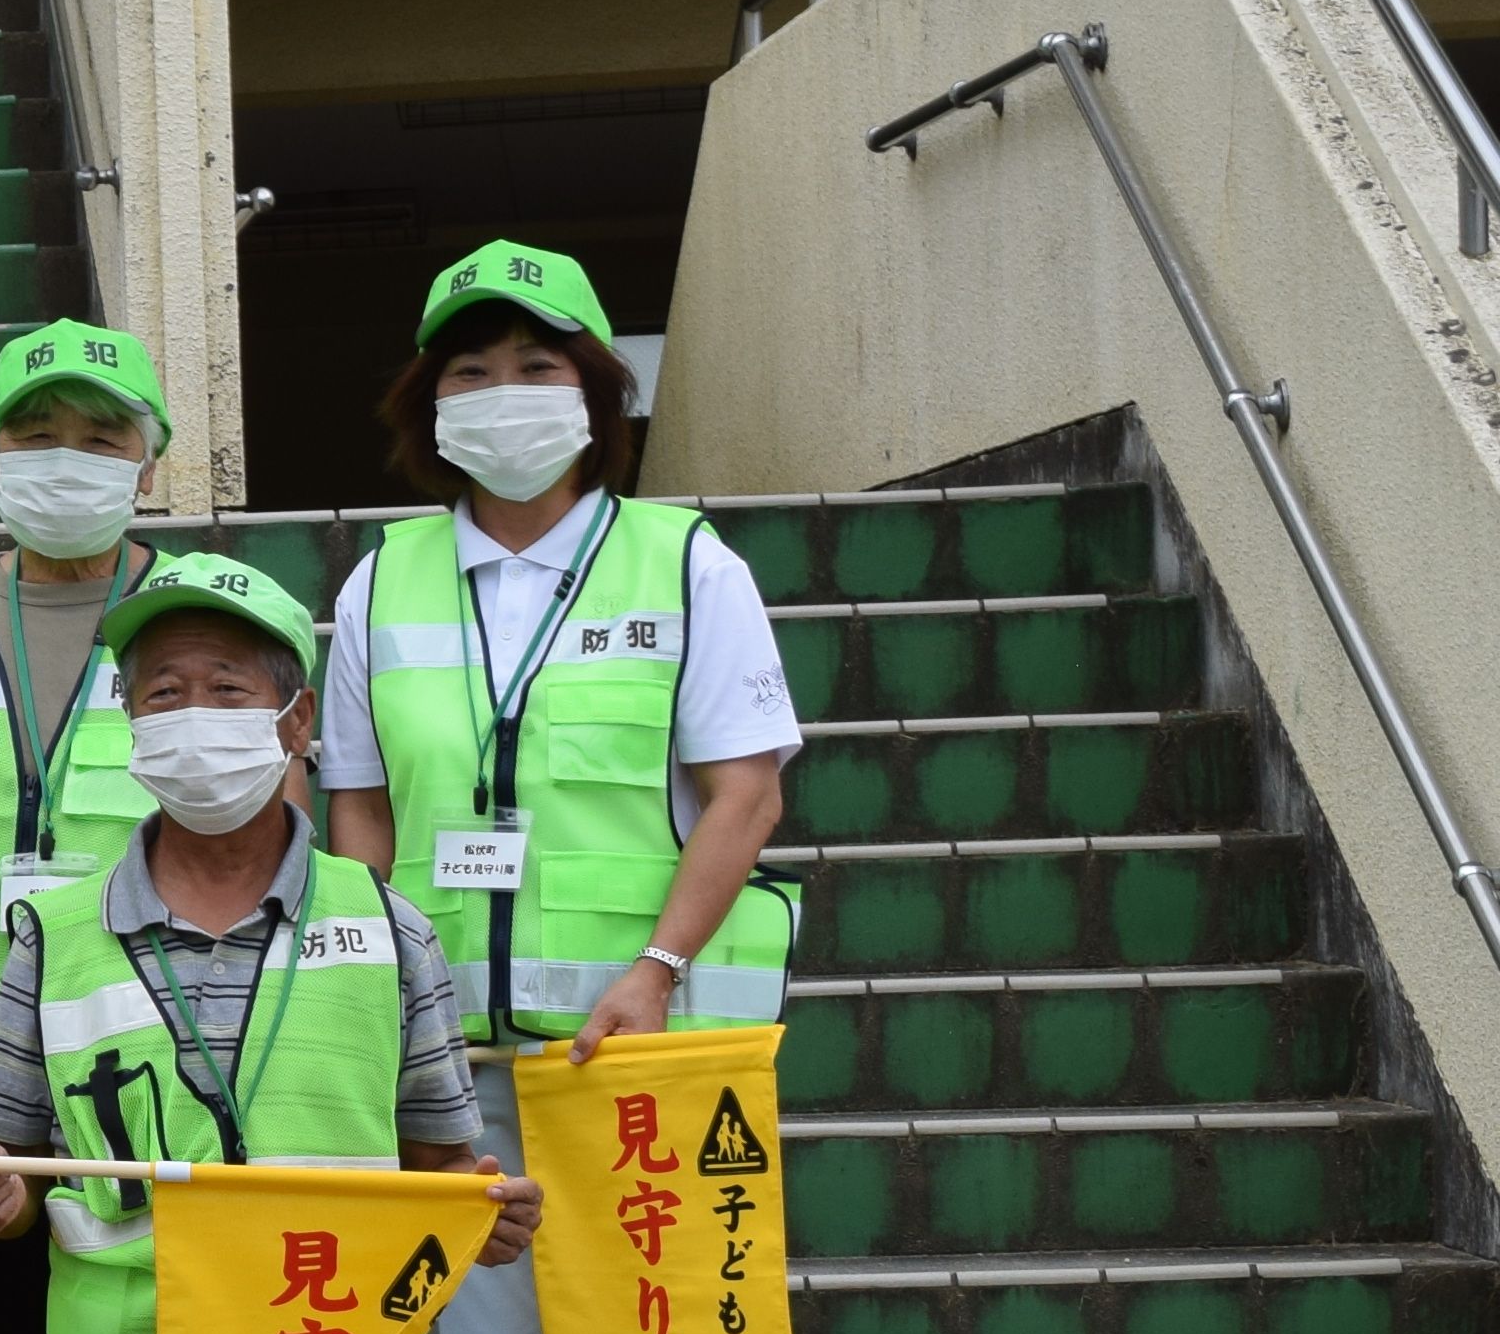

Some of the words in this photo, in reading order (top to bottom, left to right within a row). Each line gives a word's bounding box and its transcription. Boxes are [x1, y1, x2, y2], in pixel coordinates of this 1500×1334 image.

[450, 257, 543, 293] 防犯
[25, 340, 118, 375] 防犯
[581, 620, 657, 655] 防犯
[464, 844, 497, 856] 松伏町
[441, 862, 516, 875] 子ども見守り隊
